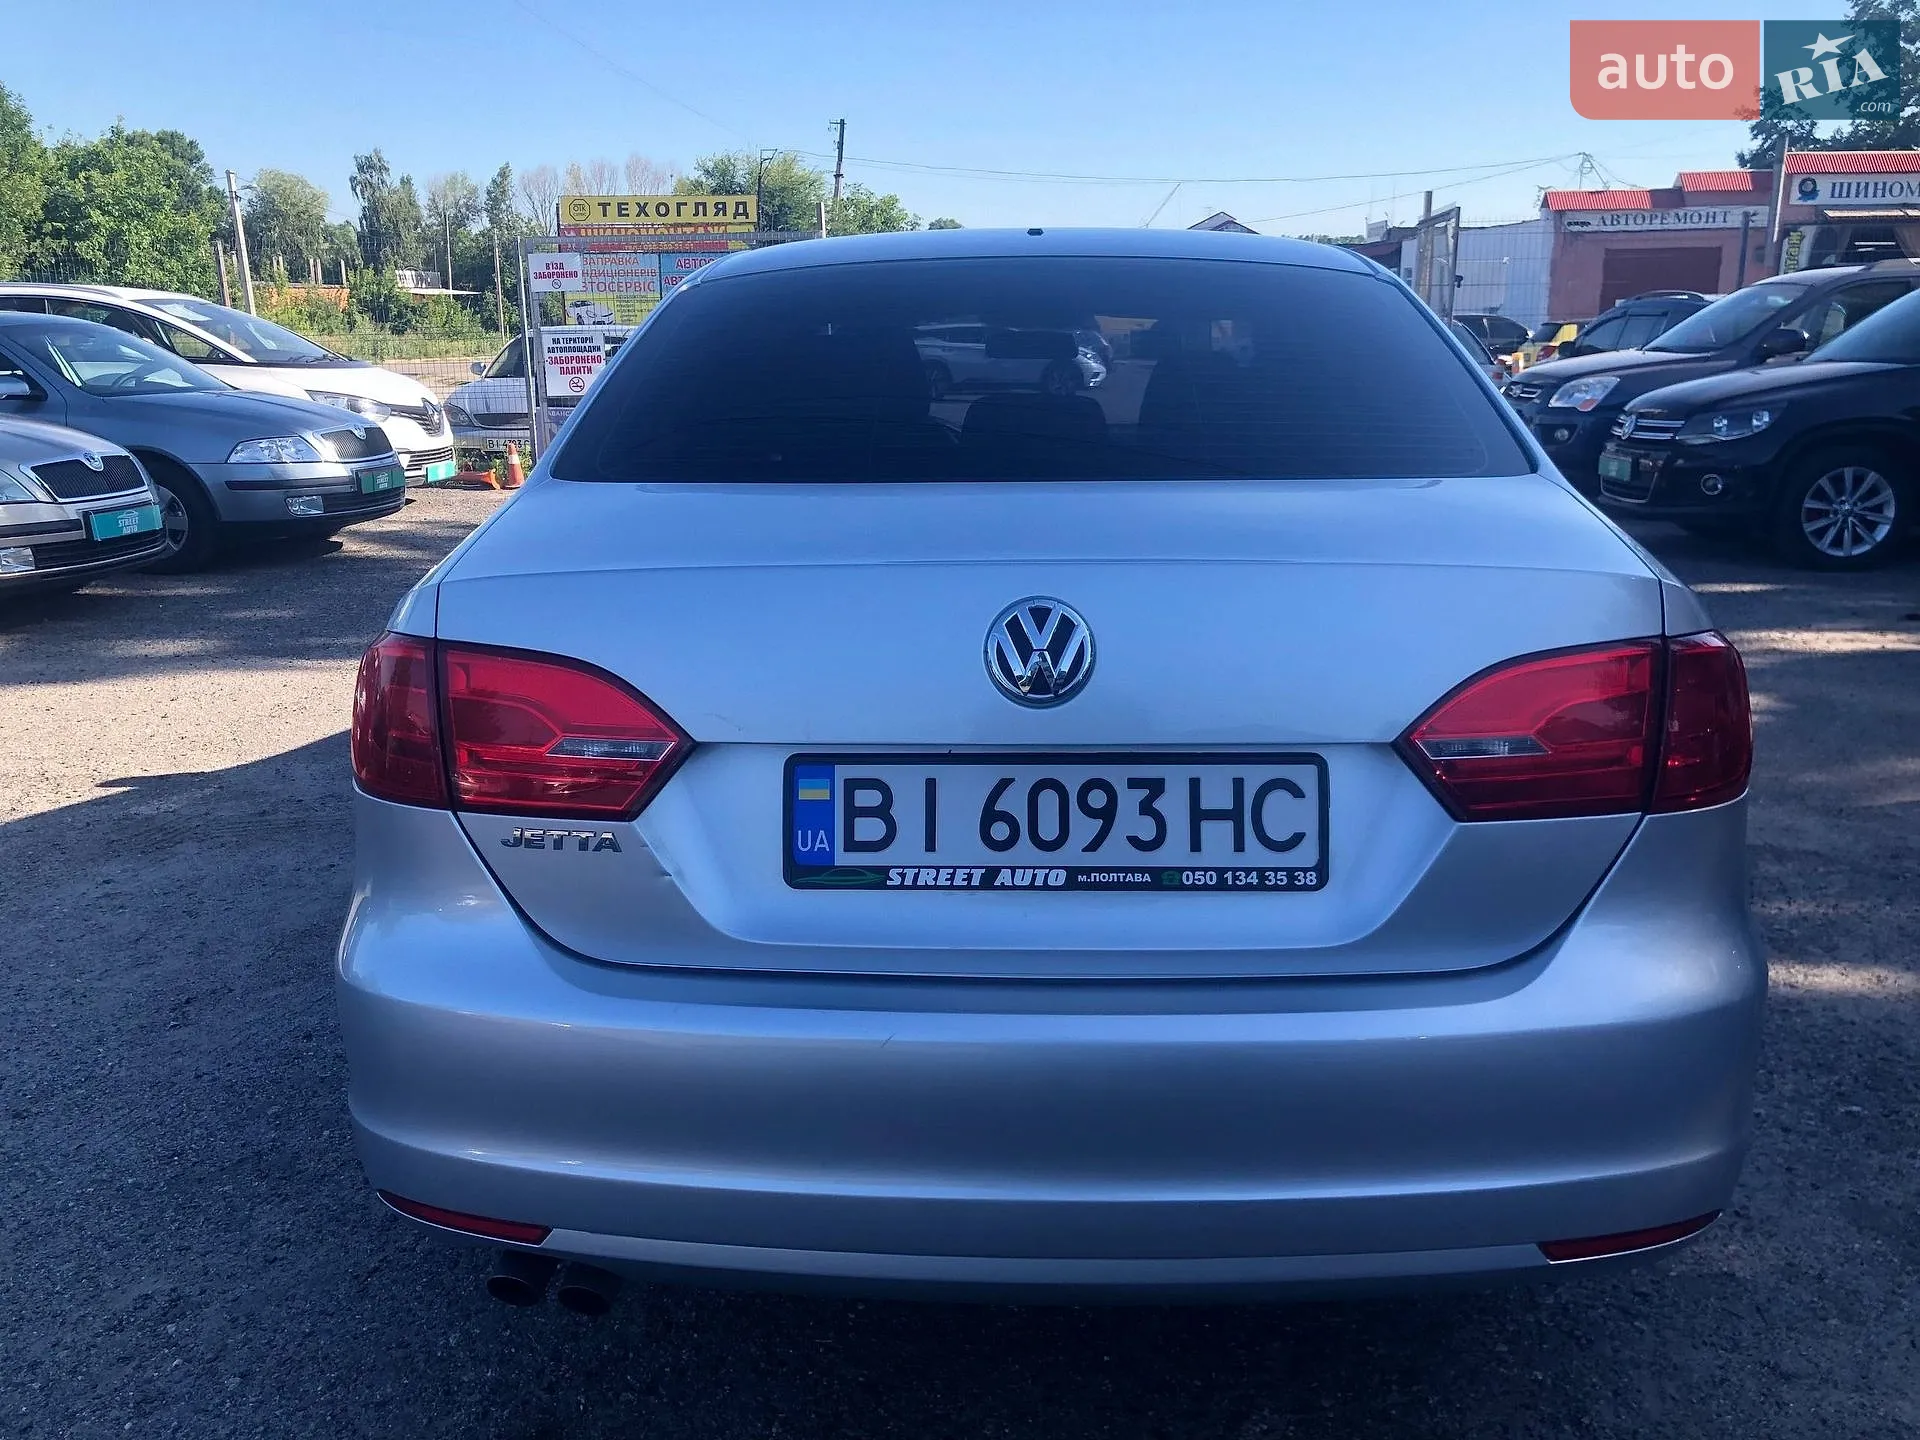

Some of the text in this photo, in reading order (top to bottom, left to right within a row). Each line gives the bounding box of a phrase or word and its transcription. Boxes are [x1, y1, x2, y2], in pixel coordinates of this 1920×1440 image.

[597, 201, 750, 220] ТЕХОГЛЯД
[1596, 210, 1731, 227] АВТОРЕМОНТ
[583, 257, 640, 266] ЗАПРАВКА
[533, 270, 579, 280] ЗАБОРОНЕНО
[552, 336, 594, 345] НА ТЕРИТОРІЇ
[547, 345, 602, 354] АВТОПЛОЩАДКИ
[548, 355, 602, 365] ЗАБОРОНЕНО
[559, 365, 593, 376] ПАЛИТИ
[843, 777, 1308, 853] BI 6093 HC
[500, 826, 622, 853] JETTA
[797, 830, 830, 853] UA
[886, 868, 1067, 887] STREET AUTO
[1077, 870, 1317, 886] м.ПОЛТАВА 050 134 35 38
